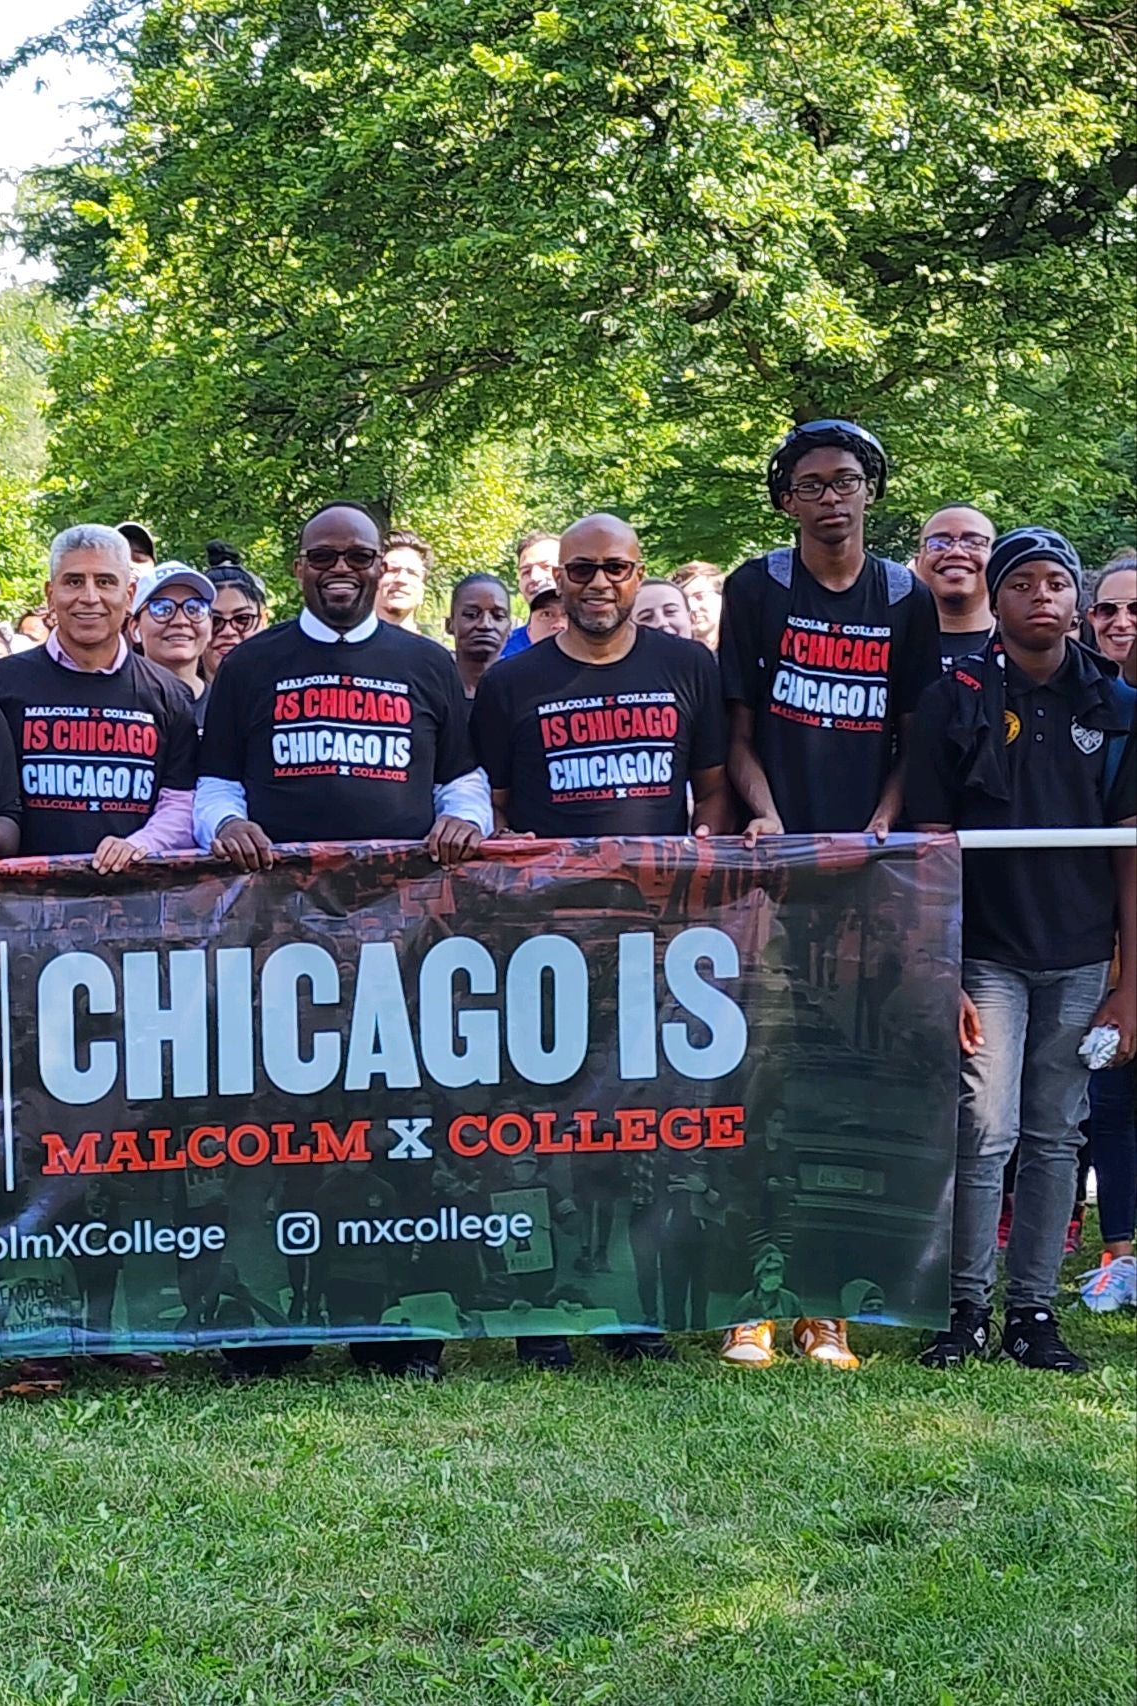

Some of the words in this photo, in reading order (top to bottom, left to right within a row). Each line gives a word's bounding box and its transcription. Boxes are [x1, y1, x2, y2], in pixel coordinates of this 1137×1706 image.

[831, 624, 841, 634] X
[842, 625, 891, 637] COLLEG
[276, 675, 340, 691] MALCOLM
[342, 676, 351, 686] X
[353, 677, 408, 694] COLLEGE
[25, 706, 89, 717] MALCOLM
[91, 708, 101, 718] X
[274, 692, 300, 720] IS
[303, 688, 411, 724] CHICAGO
[538, 697, 603, 715] MALCOLM
[605, 696, 615, 706] X
[617, 692, 676, 704] COLLEGE
[867, 686, 887, 718] IS
[23, 720, 48, 750] IS
[52, 720, 158, 757] CHICAGO
[541, 716, 568, 748] IS
[570, 706, 678, 743] CHICAGO
[821, 717, 832, 728] X
[272, 730, 382, 766] CHICAGO
[385, 735, 411, 768] IS
[22, 764, 131, 798] CHICAGO
[132, 768, 155, 801] IS
[274, 765, 337, 777] MALCOLM
[339, 765, 350, 776] X
[352, 766, 408, 782] COLLEGE
[548, 751, 652, 791] CHICAGO
[652, 751, 673, 782] IS
[90, 801, 100, 812] X
[552, 789, 614, 803] MALCOLM
[616, 788, 627, 799] X
[38, 934, 589, 1105] CHICAGO
[618, 927, 748, 1080] IS
[41, 1120, 372, 1175] MALCOLM
[387, 1118, 433, 1159] X
[448, 1106, 745, 1157] COLLEGE
[338, 1207, 533, 1247] mxcollege
